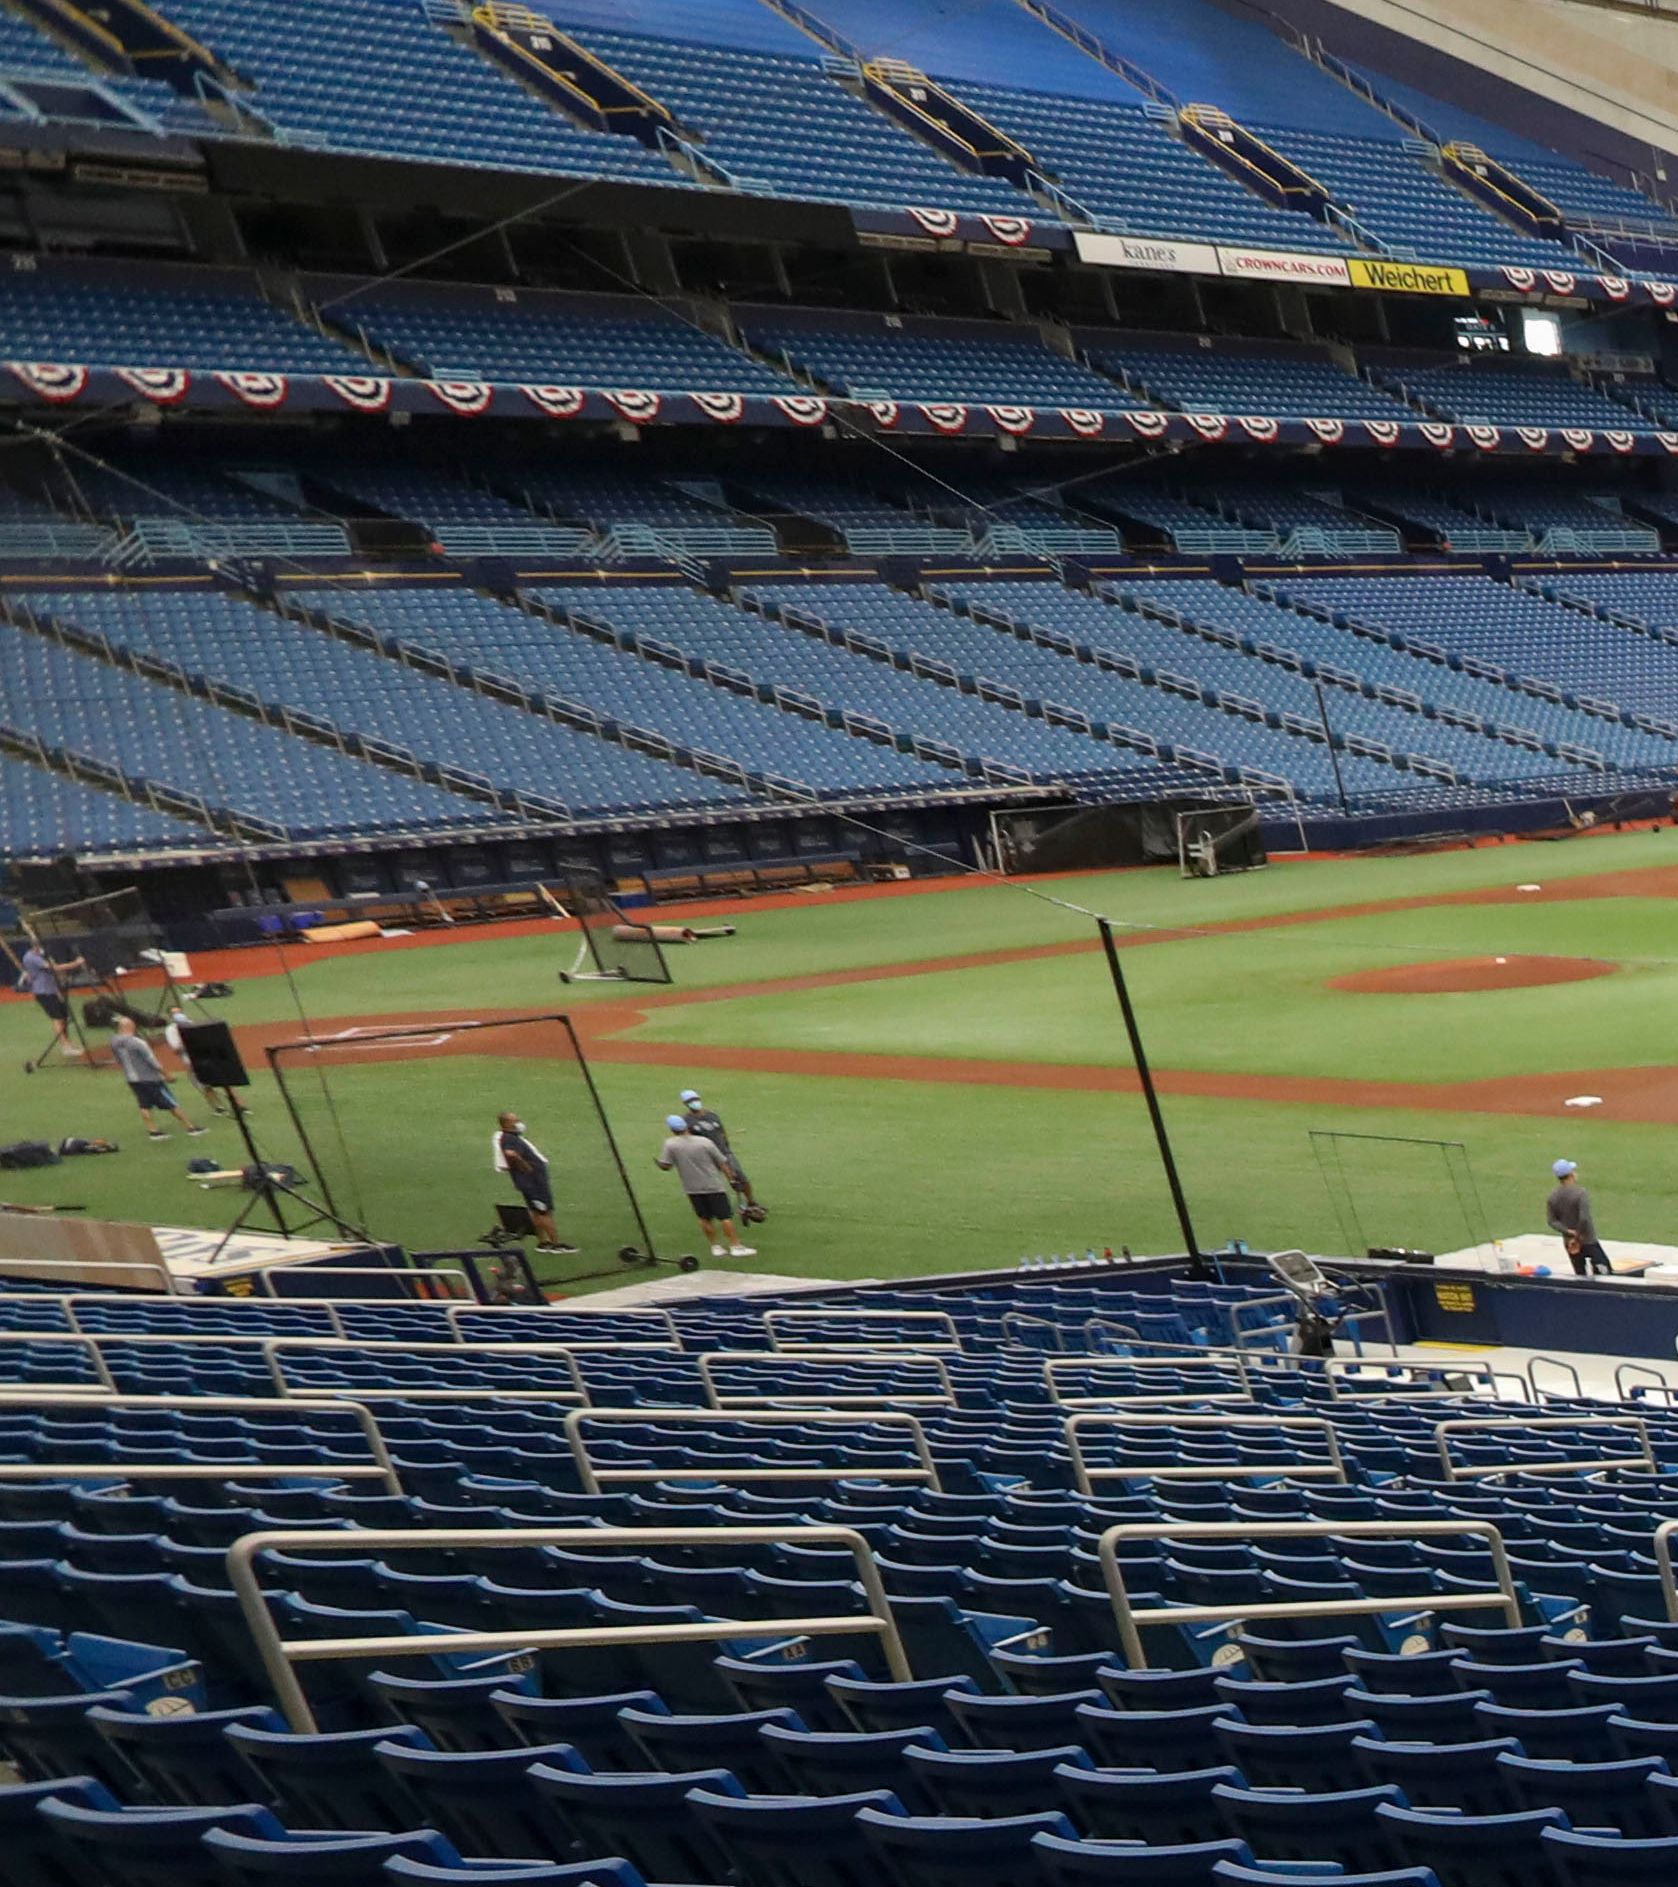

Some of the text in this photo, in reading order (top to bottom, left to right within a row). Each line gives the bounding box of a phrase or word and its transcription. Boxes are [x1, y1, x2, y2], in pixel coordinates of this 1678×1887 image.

[1121, 239, 1177, 264] kane's
[1235, 255, 1347, 279] CROWNCARS.COM
[1363, 262, 1454, 294] Weichert
